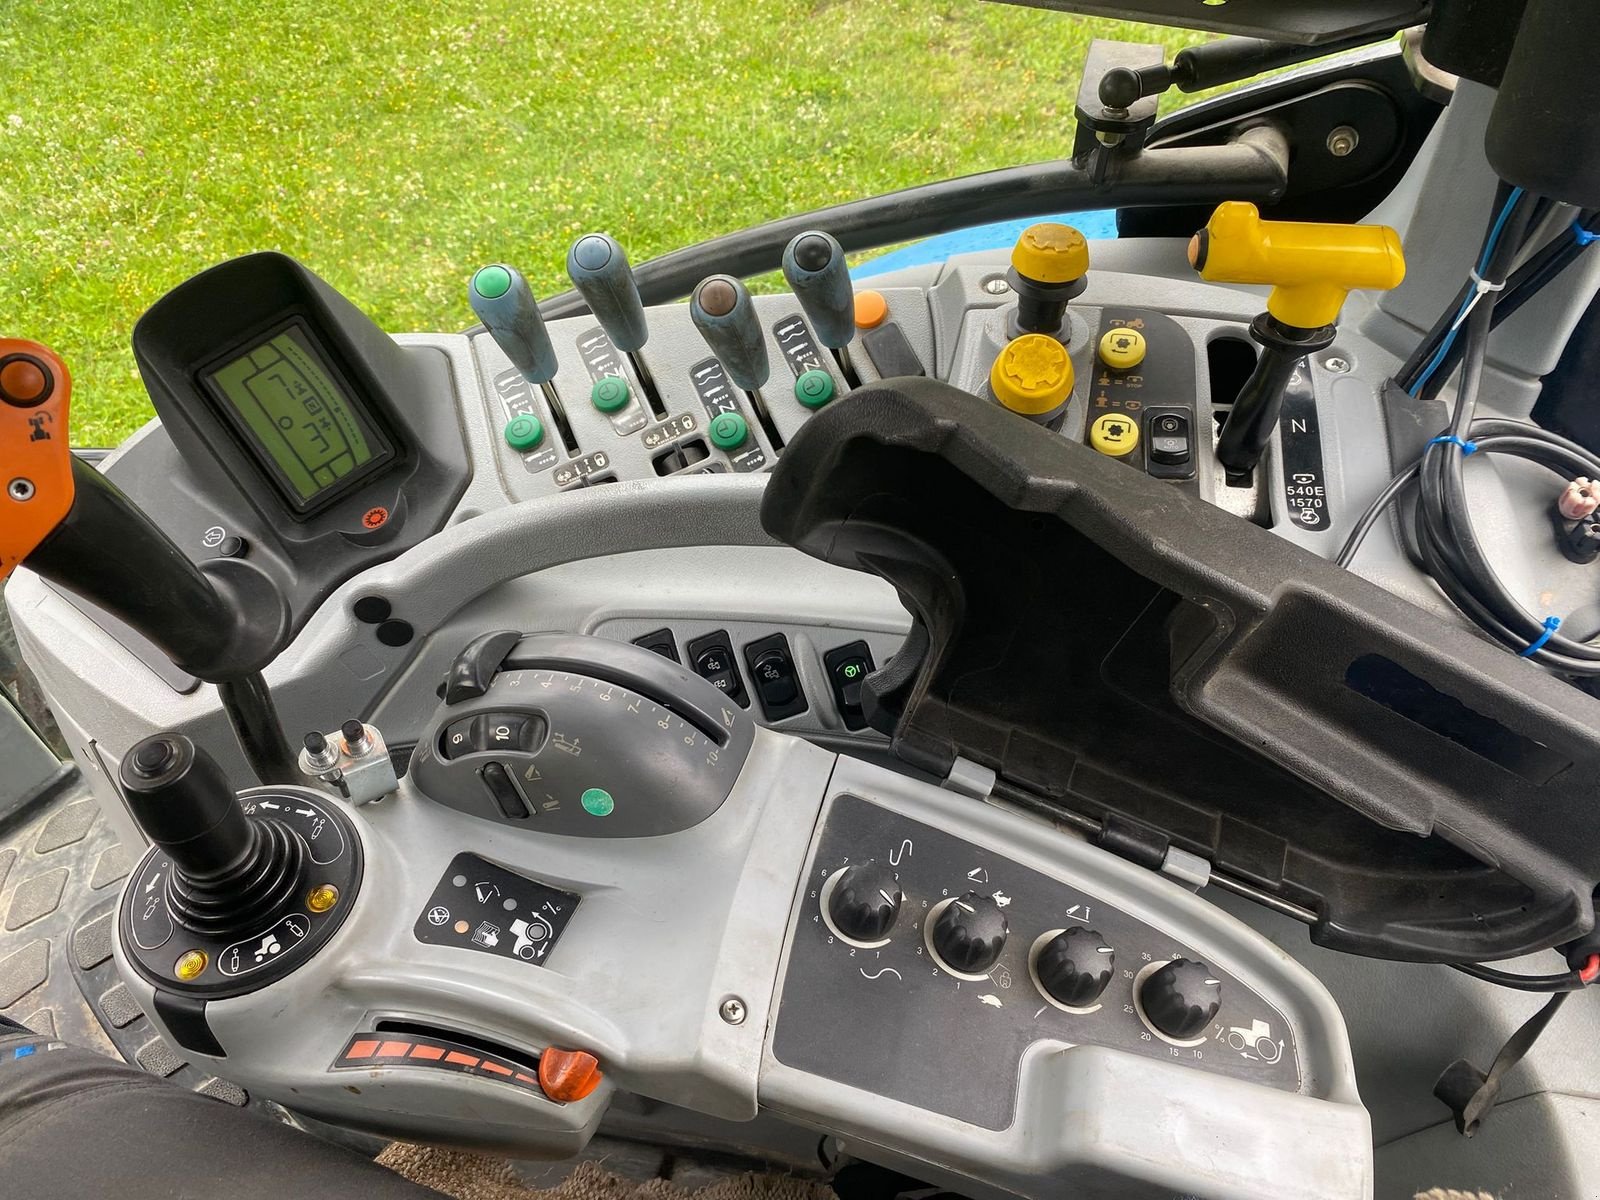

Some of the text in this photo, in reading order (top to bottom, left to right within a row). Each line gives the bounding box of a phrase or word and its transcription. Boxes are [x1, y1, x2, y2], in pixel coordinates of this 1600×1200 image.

[1291, 419, 1307, 433] N
[1287, 486, 1325, 496] 540E
[1289, 498, 1323, 508] 1570
[599, 693, 611, 702] 6
[627, 704, 640, 714] 7
[657, 720, 669, 729] 8
[684, 736, 695, 746] 9
[706, 752, 719, 767] 10
[452, 726, 510, 745] 9 10
[828, 936, 834, 944] 3
[850, 949, 856, 957] 2
[1142, 952, 1151, 961] 35
[932, 968, 938, 976] 2
[1123, 970, 1134, 979] 30
[1123, 1005, 1134, 1014] 25
[1140, 1031, 1151, 1041] 20
[1169, 1047, 1179, 1056] 15
[1192, 1050, 1203, 1059] 10
